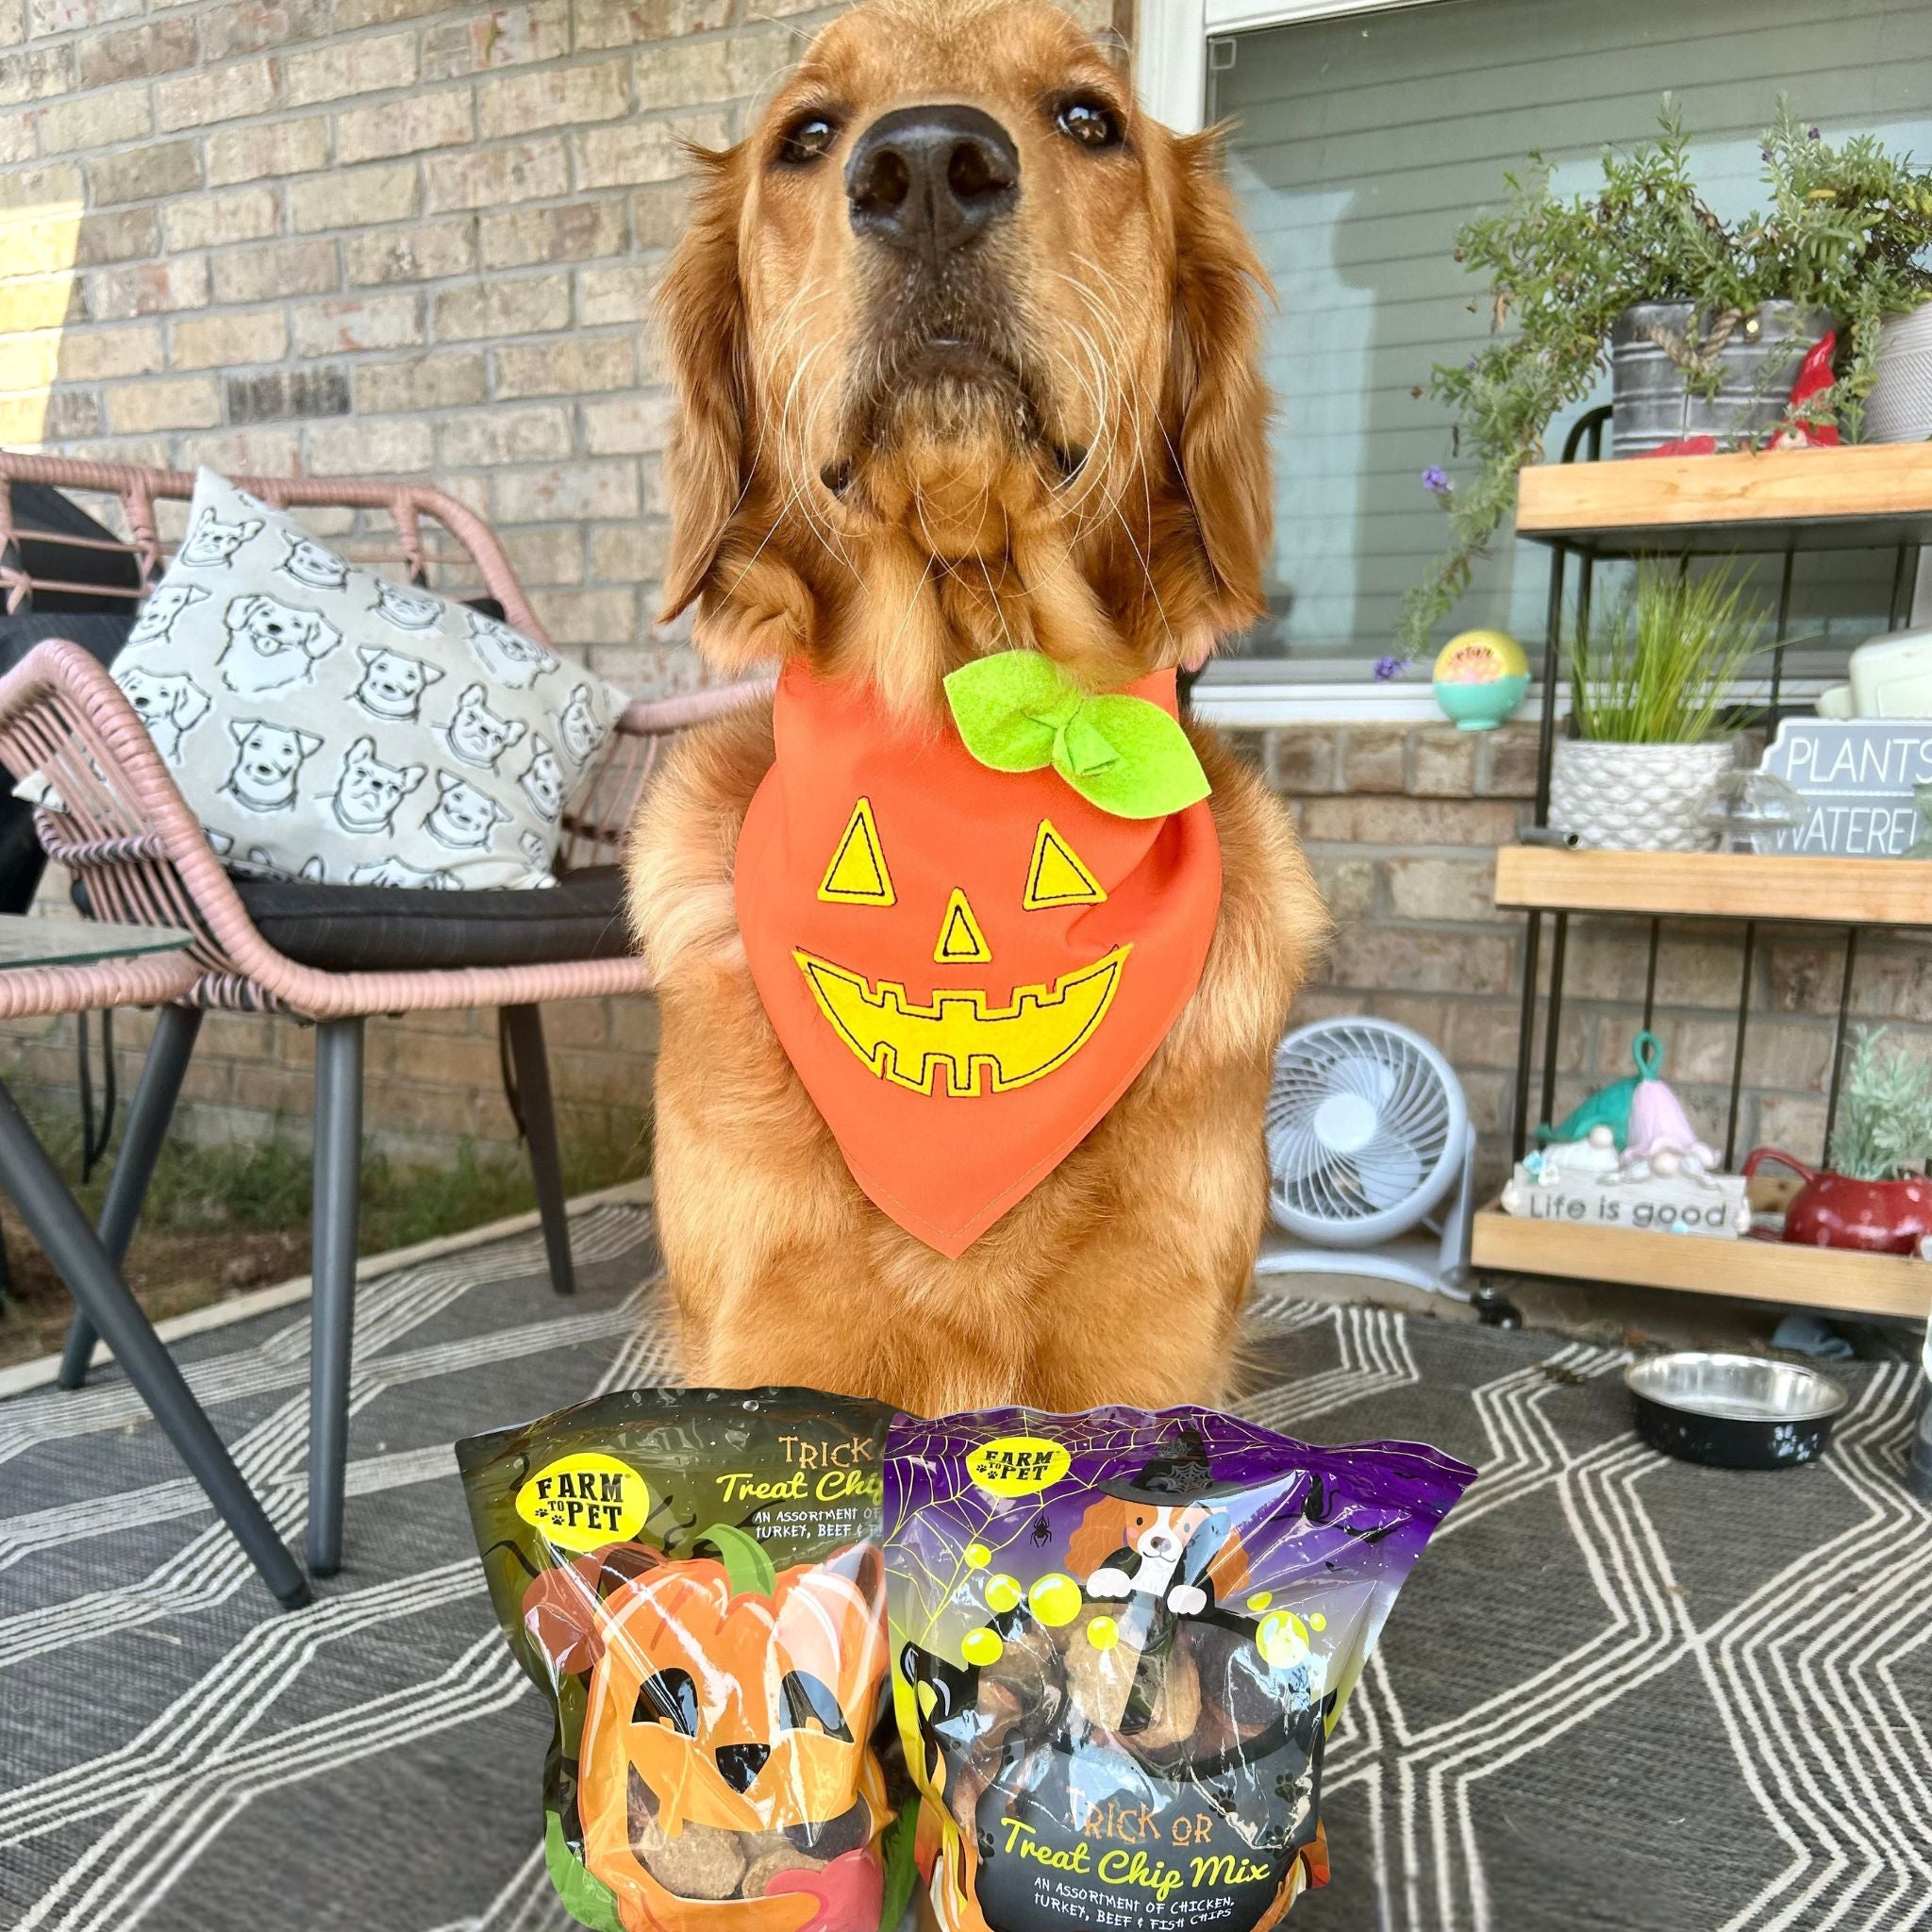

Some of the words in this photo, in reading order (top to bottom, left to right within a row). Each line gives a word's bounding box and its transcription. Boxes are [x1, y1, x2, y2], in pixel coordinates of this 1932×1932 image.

[1776, 807, 1917, 855] WATERE
[1529, 1193, 1586, 1219] Life
[1599, 1194, 1621, 1221] is
[1632, 1201, 1727, 1227] good
[778, 1436, 874, 1470] TRICK
[985, 1450, 1055, 1467] FARM
[716, 1471, 808, 1502] Treat
[989, 1461, 1001, 1470] TO
[1000, 1464, 1048, 1481] PET
[536, 1473, 624, 1503] FARM
[547, 1500, 565, 1511] TO
[566, 1501, 623, 1532] PET
[755, 1510, 772, 1524] AN
[776, 1507, 858, 1523] ASSORTMENT
[863, 1507, 882, 1520] OF
[755, 1524, 811, 1540] TURKEY,
[817, 1524, 852, 1538] BEEF
[1065, 1785, 1162, 1844] TRICK
[1171, 1812, 1213, 1846] OR
[1000, 1817, 1091, 1874] Treat
[1097, 1849, 1185, 1902] Chip
[1190, 1855, 1271, 1888] Mix
[1034, 1876, 1050, 1891] AN
[1056, 1882, 1141, 1912] ASSORTMENT
[1145, 1901, 1166, 1914] OF
[1170, 1896, 1235, 1914] CHICKEN,
[1034, 1891, 1090, 1922] TURKEY,
[1095, 1908, 1133, 1927] BEEF
[1150, 1917, 1185, 1931] FISH
[1190, 1907, 1232, 1925] CHIPS
